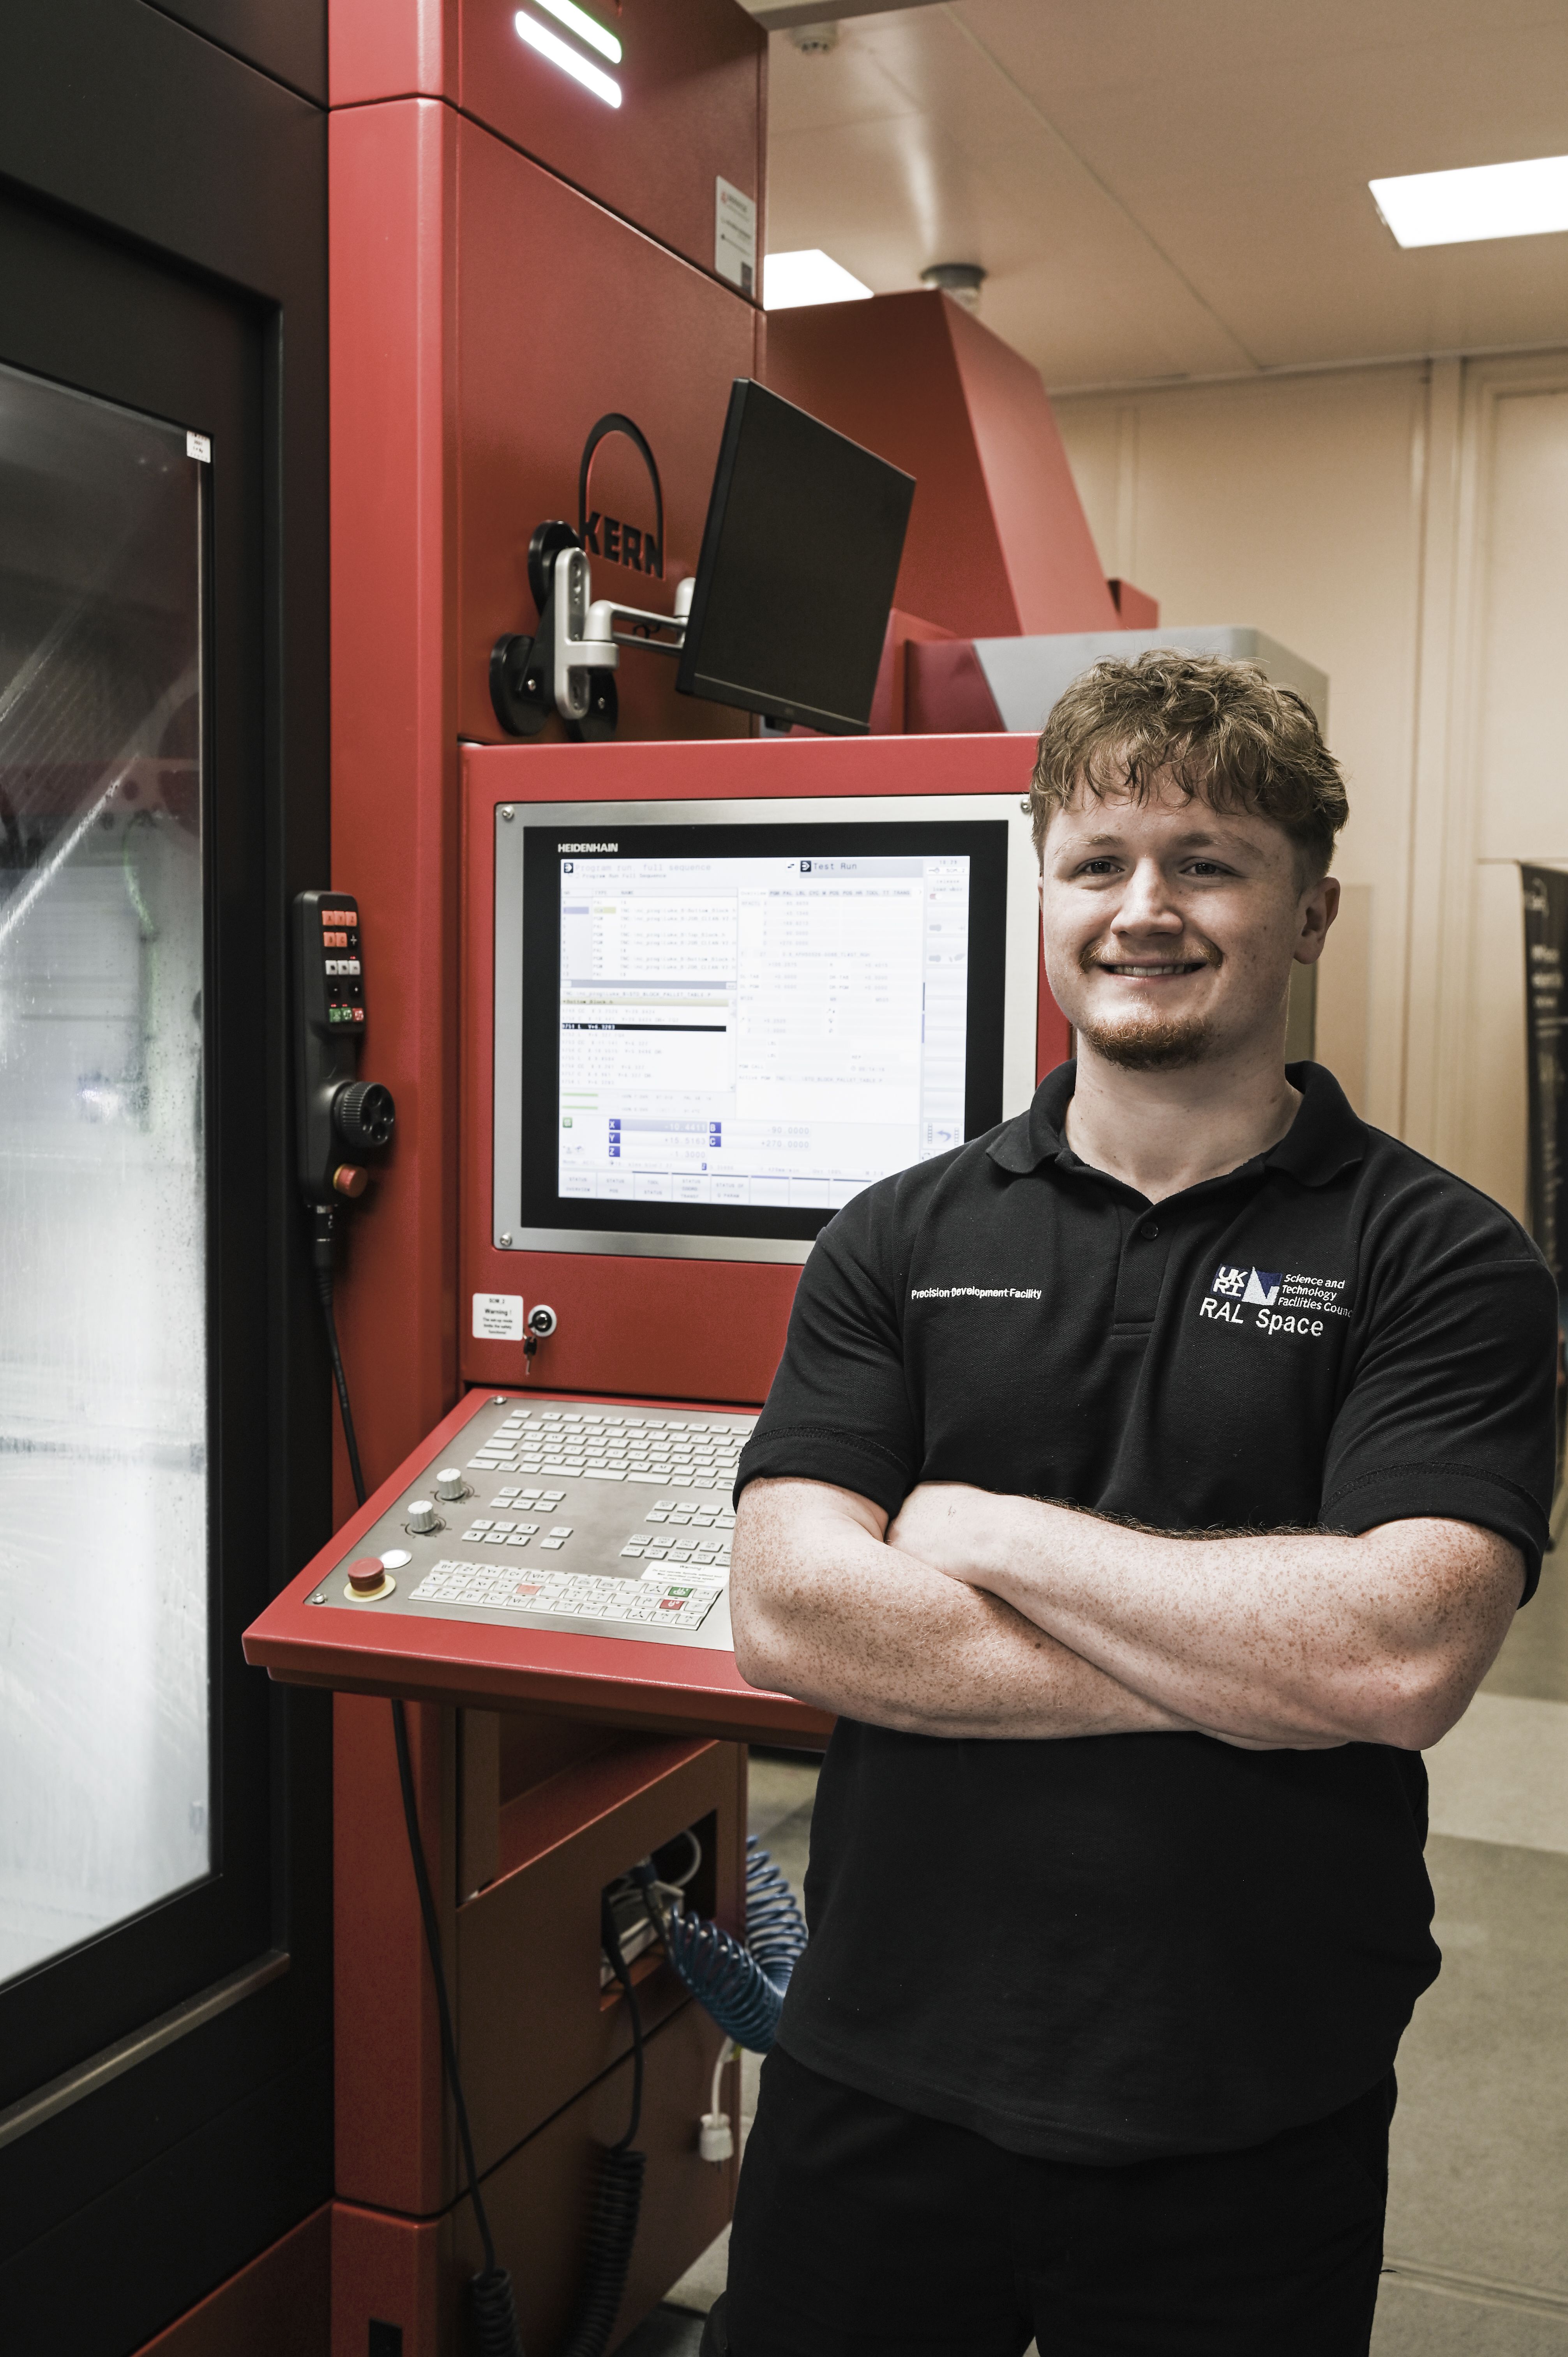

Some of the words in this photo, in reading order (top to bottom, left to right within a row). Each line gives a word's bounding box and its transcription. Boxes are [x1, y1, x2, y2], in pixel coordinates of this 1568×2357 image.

[579, 511, 663, 578] KERN
[558, 843, 618, 853] HEIDENHAIN
[575, 864, 611, 872] Program
[1284, 1274, 1323, 1286] Science
[1324, 1280, 1345, 1289] and
[911, 1287, 950, 1300] Precision
[951, 1286, 1008, 1299] Development
[1009, 1288, 1042, 1300] Facility
[1282, 1285, 1337, 1301] Technology
[1278, 1297, 1322, 1310] Facilities
[485, 1308, 508, 1316] Warning
[1199, 1297, 1244, 1324] RAL
[1255, 1308, 1324, 1337] Space
